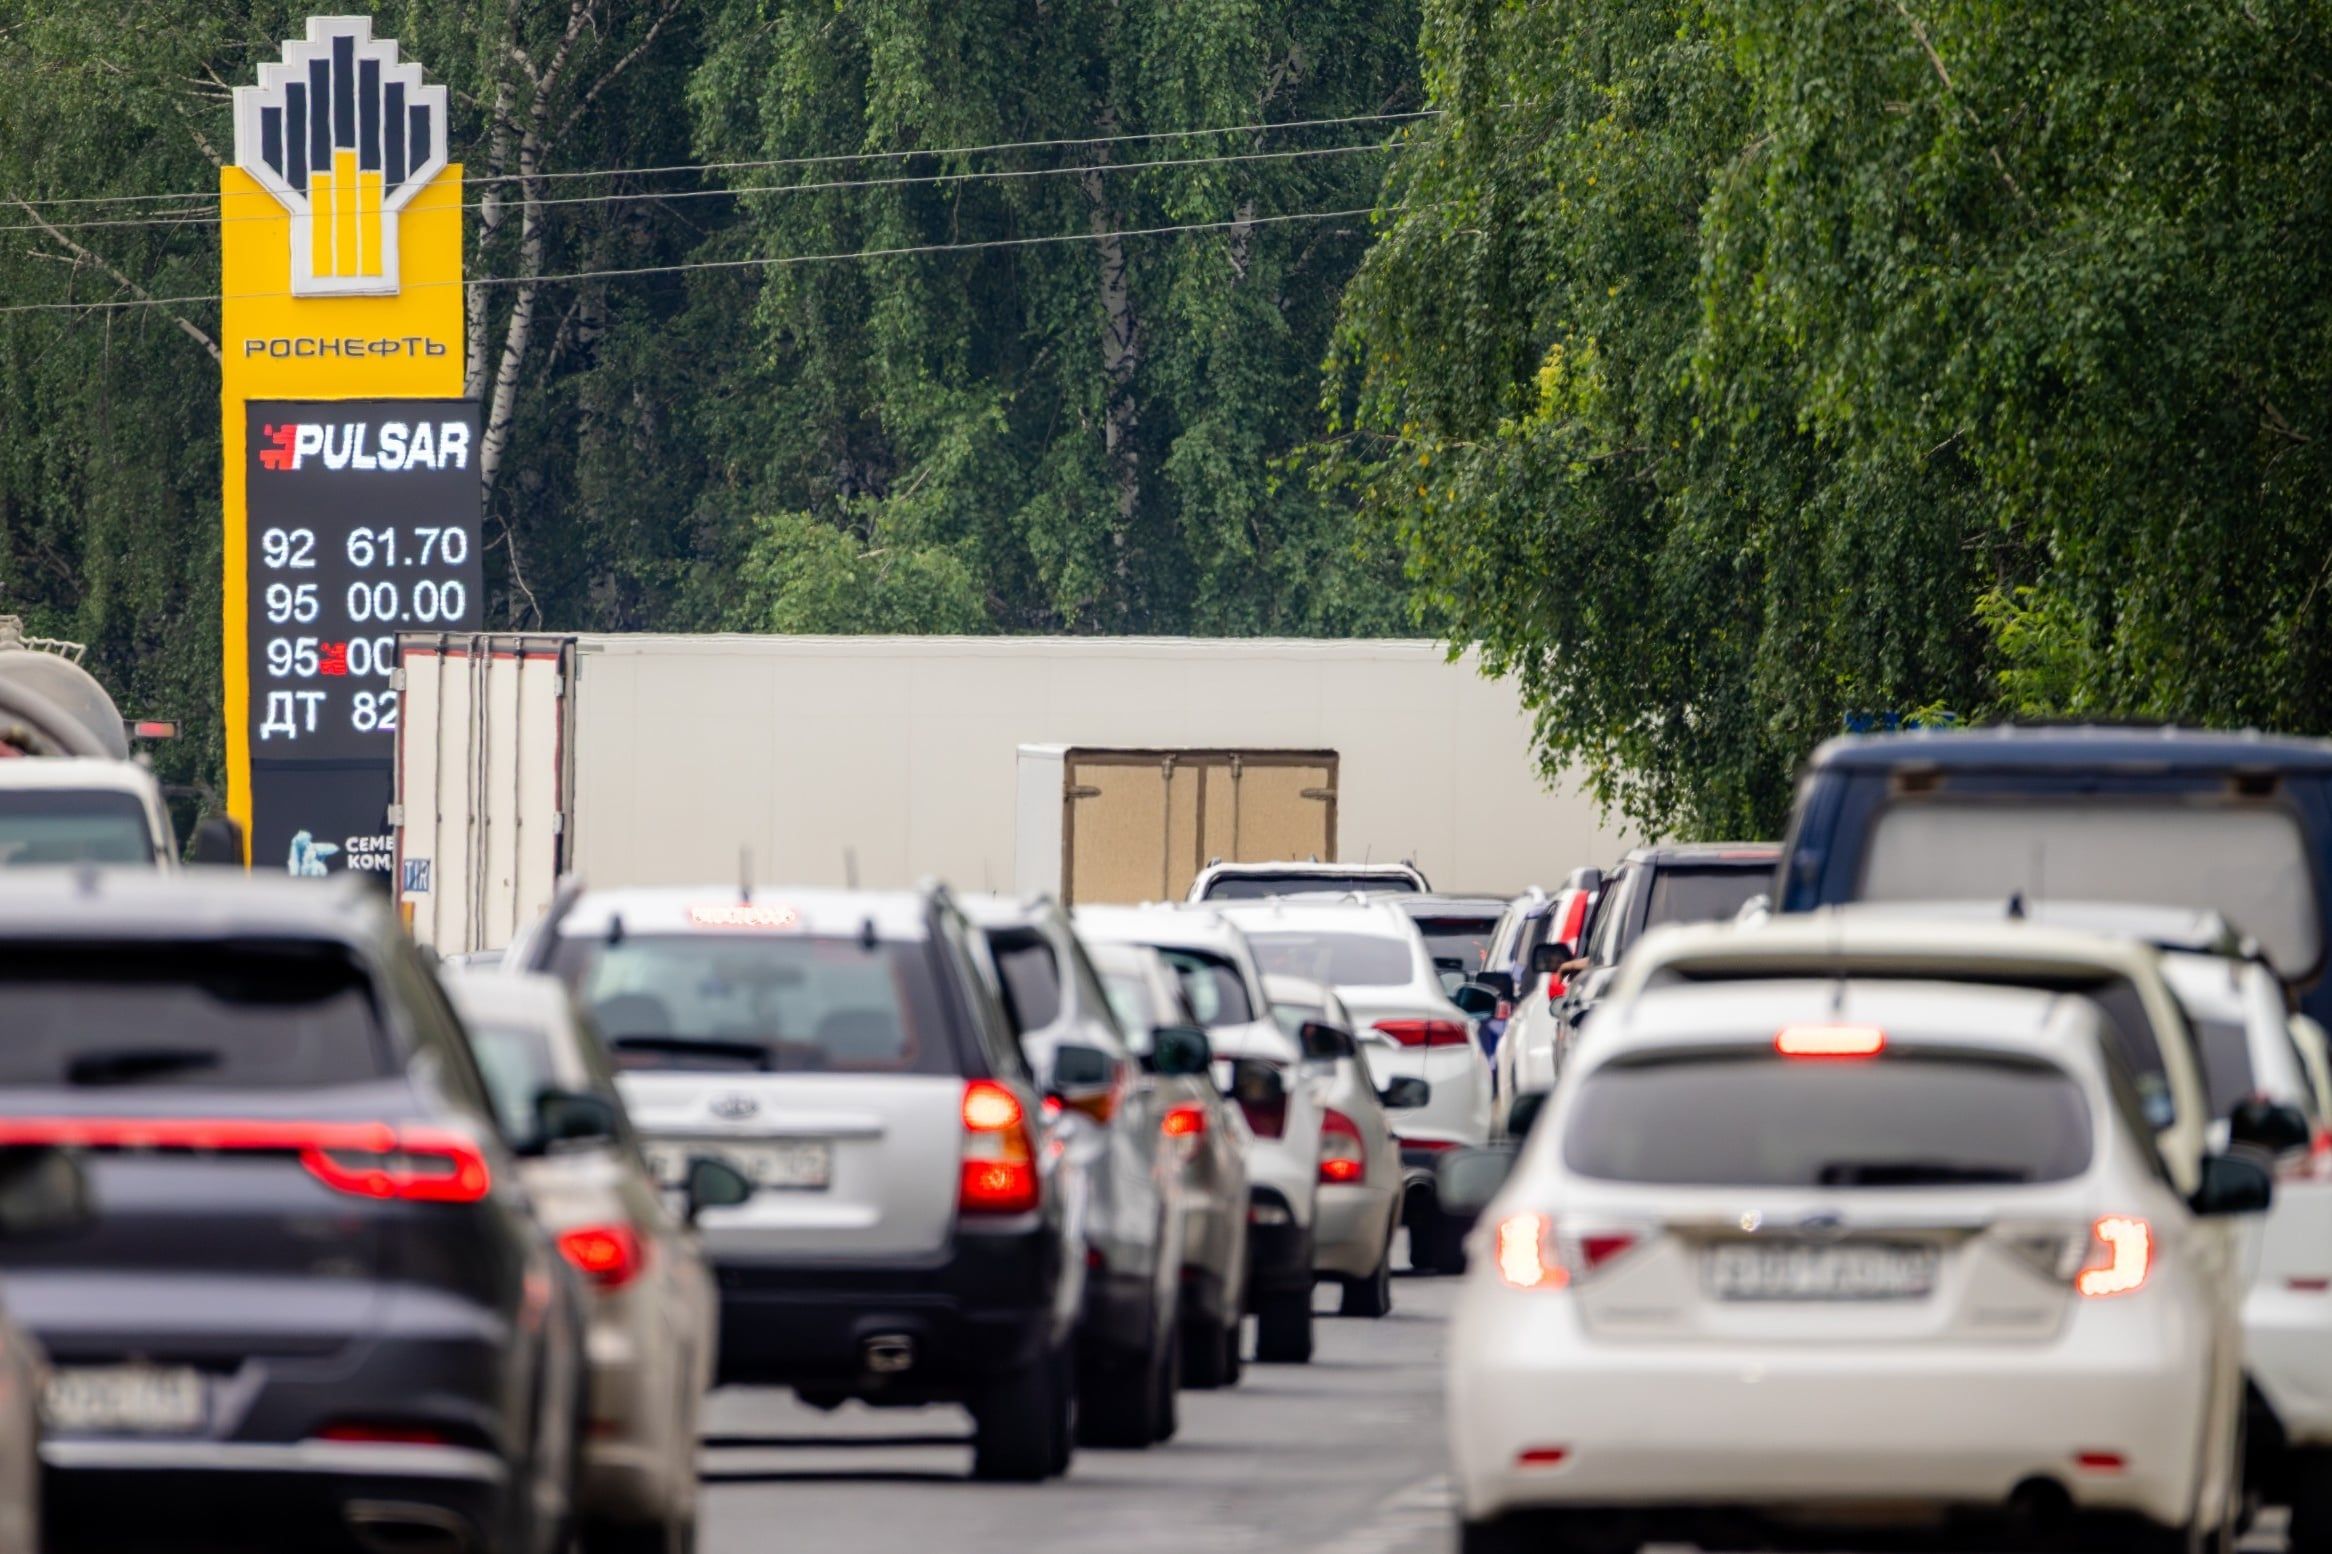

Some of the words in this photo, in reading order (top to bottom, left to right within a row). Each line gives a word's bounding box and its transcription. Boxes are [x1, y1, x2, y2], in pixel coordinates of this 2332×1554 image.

[244, 337, 446, 358] РОСНЕФТЬ
[292, 421, 470, 470] PULSAR
[262, 527, 316, 568] 92
[347, 526, 468, 567] 61.70
[266, 582, 319, 623] 95
[347, 580, 465, 621] 00.00
[267, 637, 319, 677] 95
[260, 691, 326, 739] ДТ
[347, 853, 393, 871] КОМ
